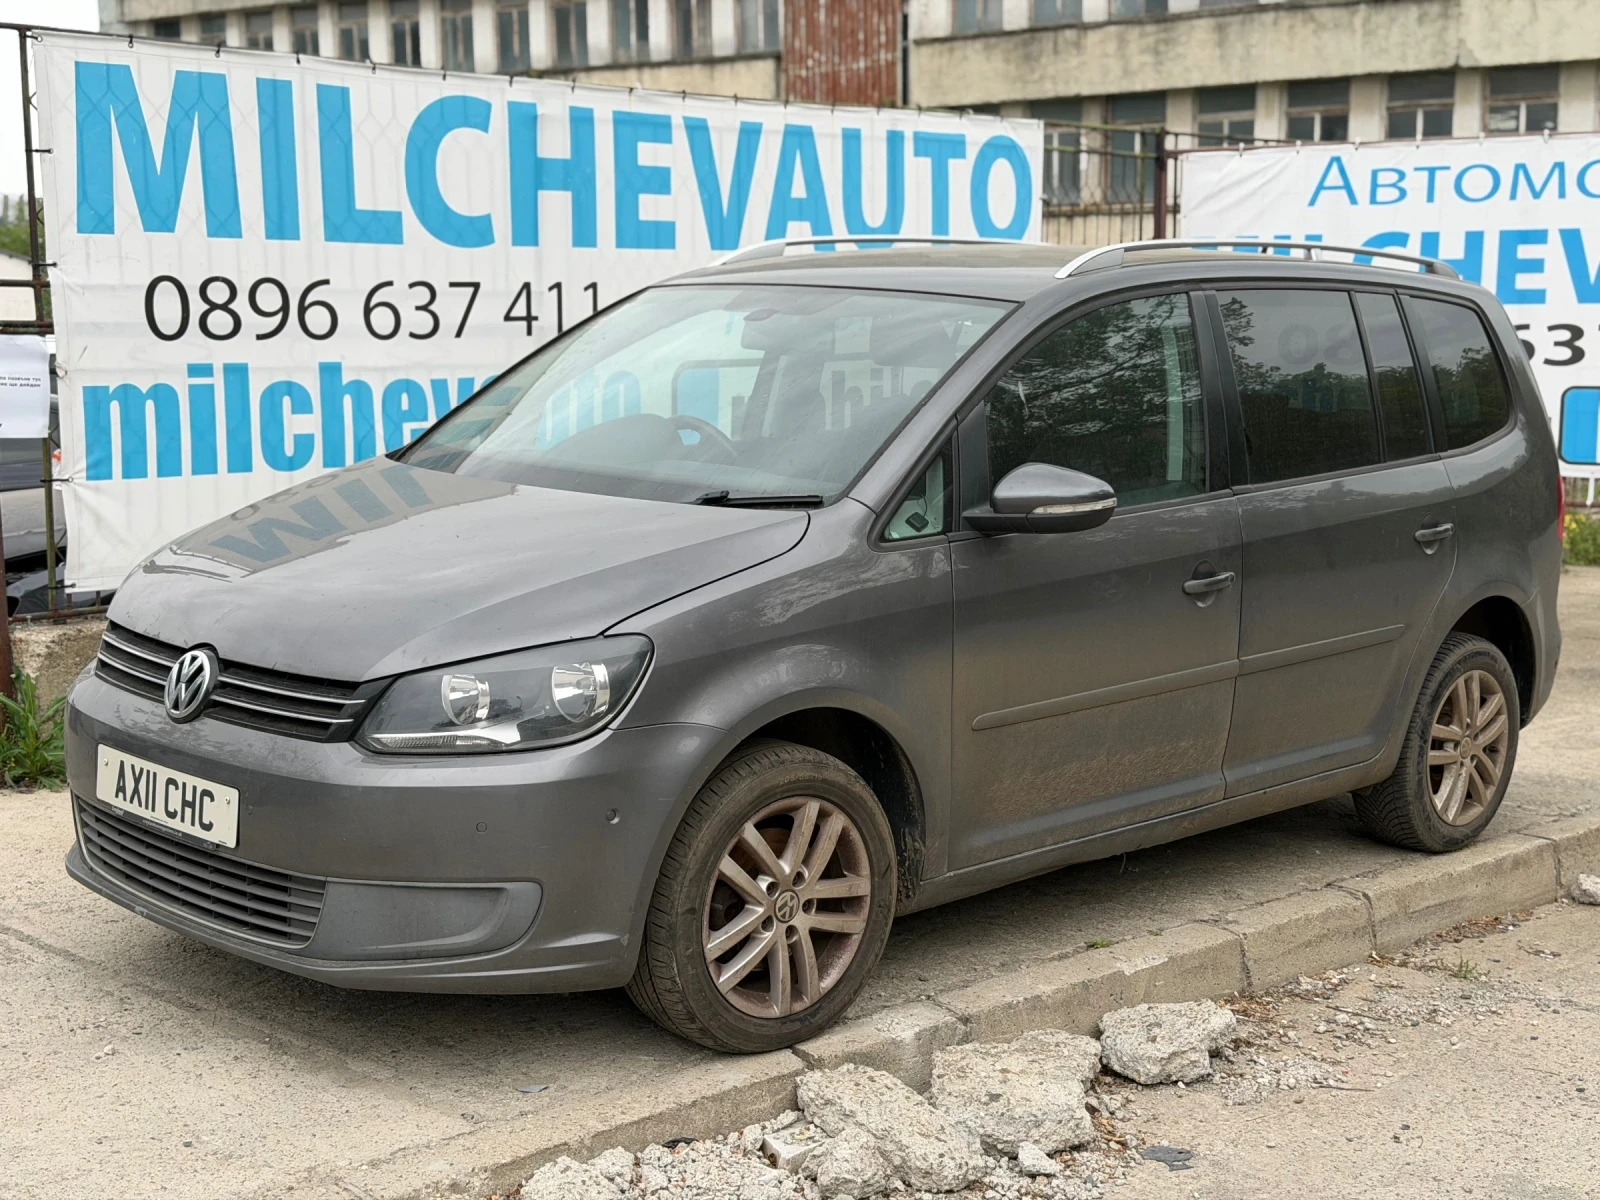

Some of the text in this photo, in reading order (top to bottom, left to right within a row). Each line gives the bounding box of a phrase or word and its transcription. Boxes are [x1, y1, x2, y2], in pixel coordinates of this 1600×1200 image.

[75, 61, 1033, 252] MILCHEVAUTO
[144, 275, 599, 341] 0896 637 411
[115, 759, 157, 812] AX11
[164, 777, 215, 832] CHC
